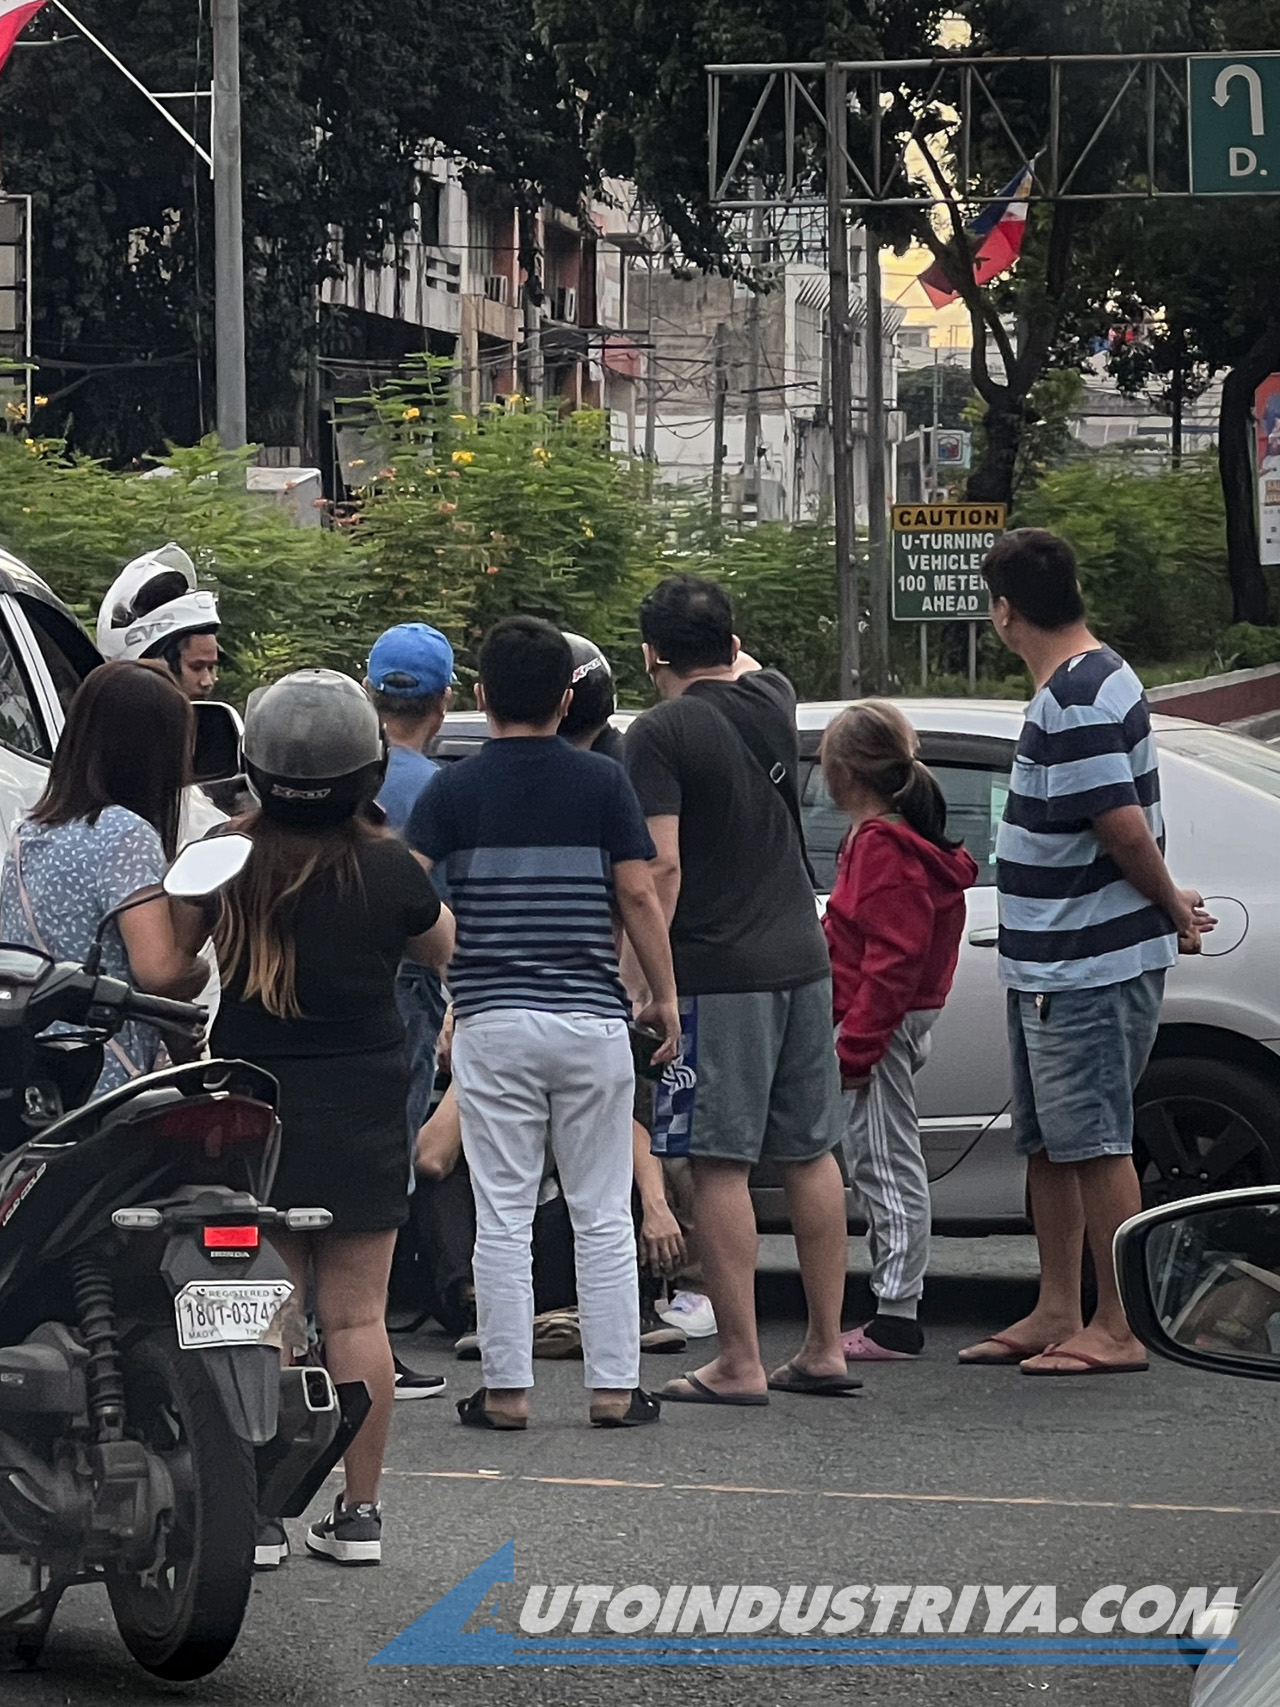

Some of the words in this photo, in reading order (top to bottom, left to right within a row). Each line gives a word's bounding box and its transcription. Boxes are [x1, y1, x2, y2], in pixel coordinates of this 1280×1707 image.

[899, 510, 999, 526] CAUTION
[901, 533, 995, 550] U-TURNING
[898, 575, 926, 592] 100
[922, 595, 978, 612] AHEAD
